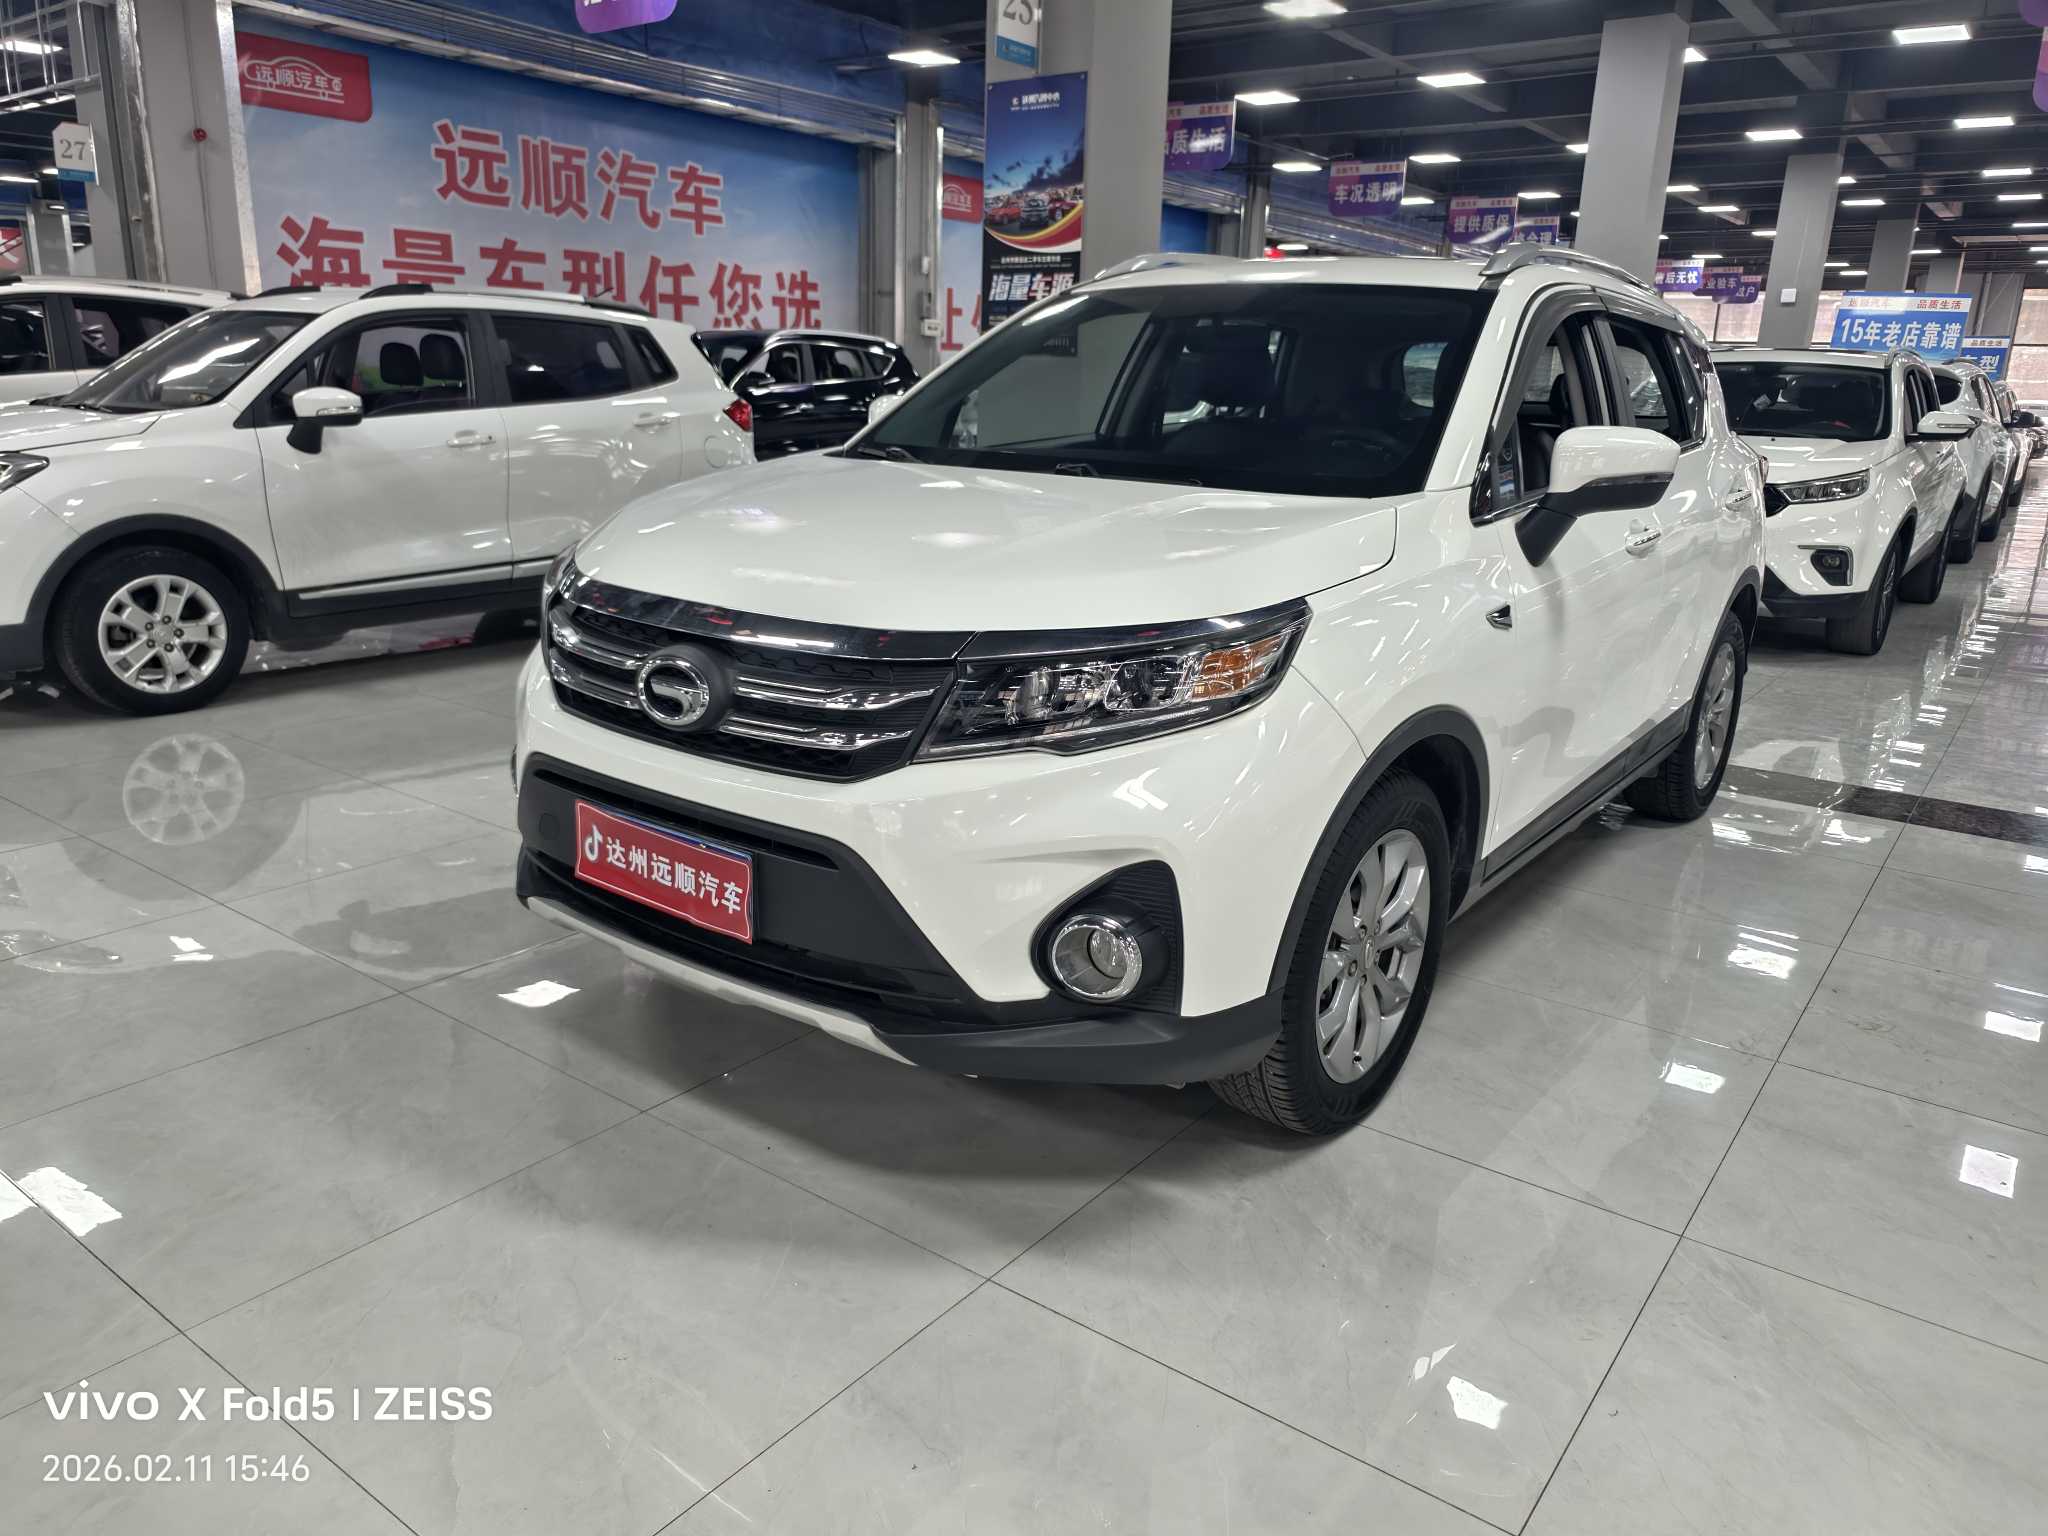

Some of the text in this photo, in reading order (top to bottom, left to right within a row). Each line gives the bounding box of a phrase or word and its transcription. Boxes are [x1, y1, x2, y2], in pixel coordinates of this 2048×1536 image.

[255, 64, 329, 90] 远顺汽车
[60, 139, 86, 161] 27
[1163, 126, 1226, 155] 质生活
[432, 119, 725, 238] 远顺汽车
[1334, 181, 1398, 205] 车况透明
[1454, 213, 1511, 233] 提供质保
[1917, 299, 1963, 310] 品质生活
[1841, 317, 1963, 350] 15年老店靠谱
[606, 836, 744, 915] 达州远顺汽车
